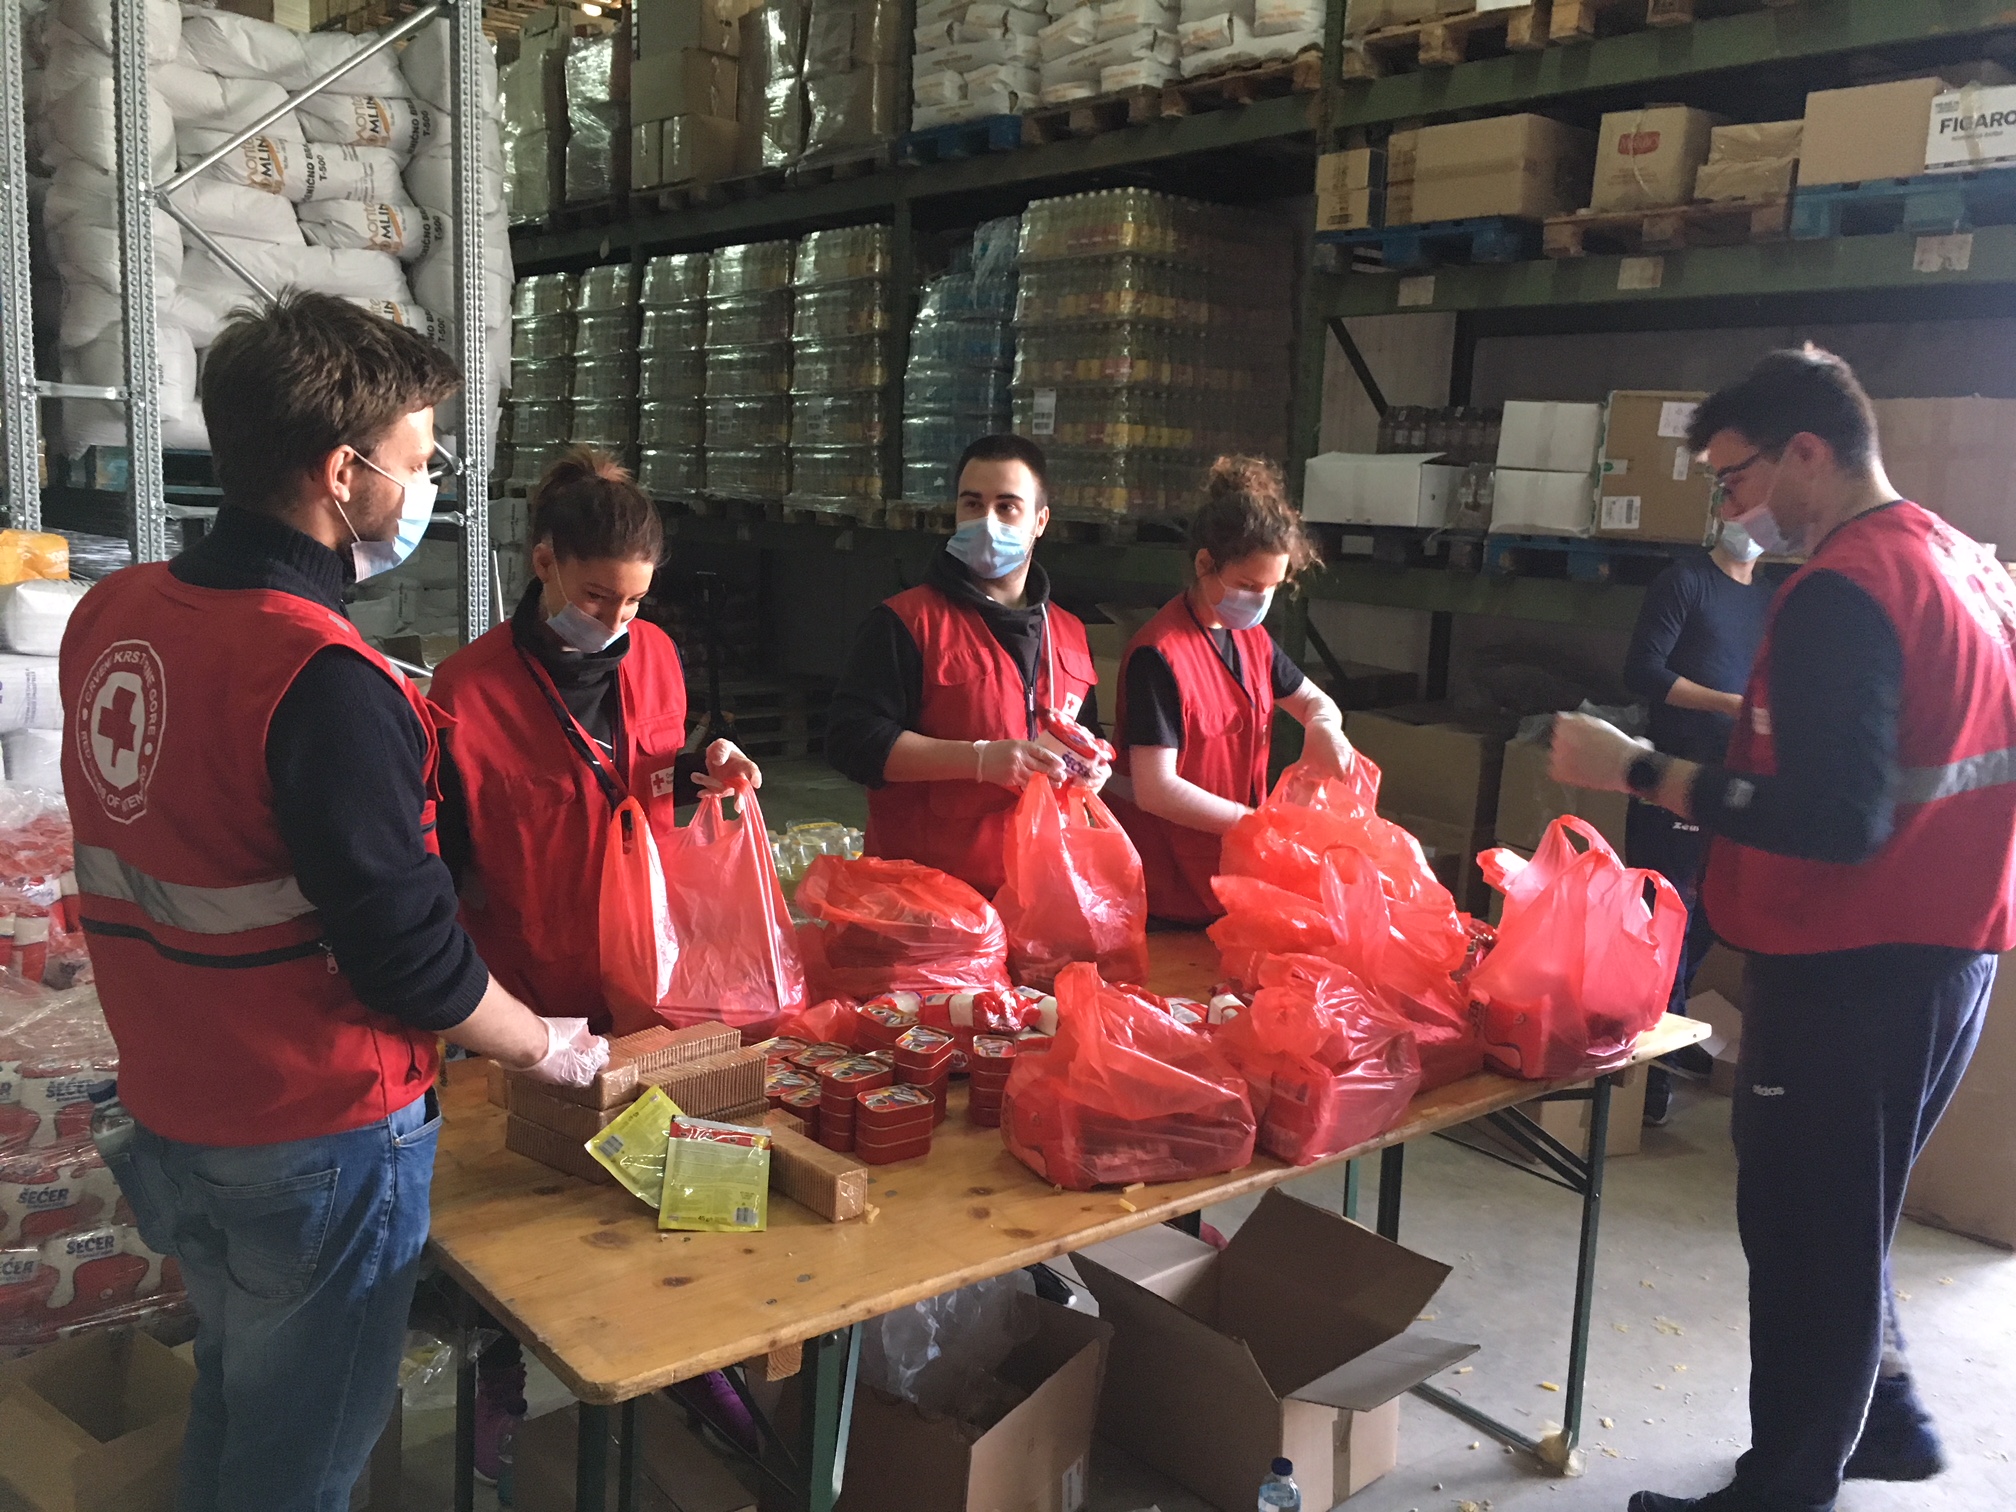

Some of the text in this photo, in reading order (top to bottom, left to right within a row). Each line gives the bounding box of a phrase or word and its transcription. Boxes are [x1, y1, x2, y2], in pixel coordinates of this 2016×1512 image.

[1939, 109, 2016, 134] FIGARO
[255, 136, 272, 177] MLIN
[316, 154, 328, 181] T-500
[17, 1186, 69, 1204] ŠEĆER
